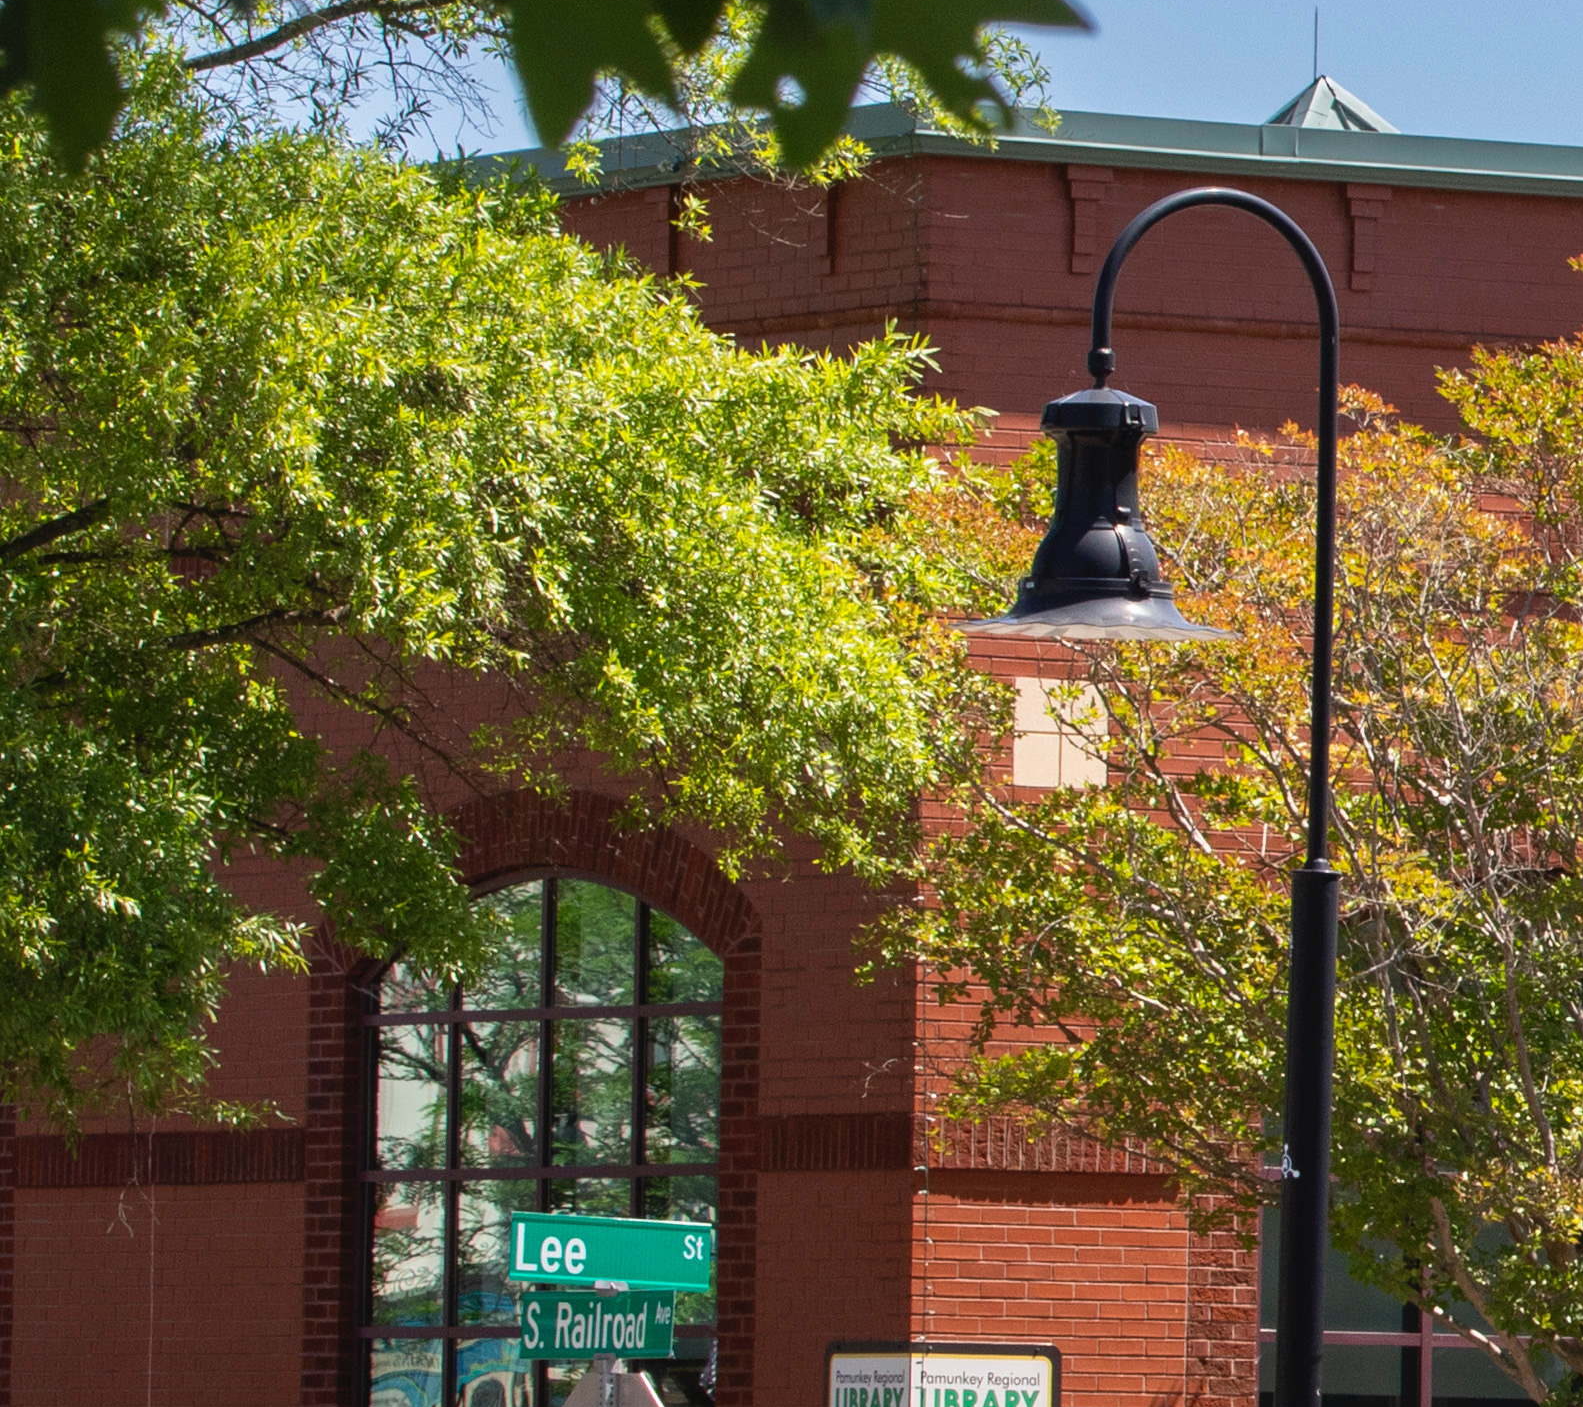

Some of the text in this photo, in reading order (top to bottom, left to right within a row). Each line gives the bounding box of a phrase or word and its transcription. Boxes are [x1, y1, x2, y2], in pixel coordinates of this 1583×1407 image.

[515, 1222, 704, 1275] Lee St
[523, 1300, 671, 1349] S. Railroad Ave
[836, 1370, 905, 1386] Pamunkey Regional
[921, 1370, 1040, 1389] Pamunkey Regional
